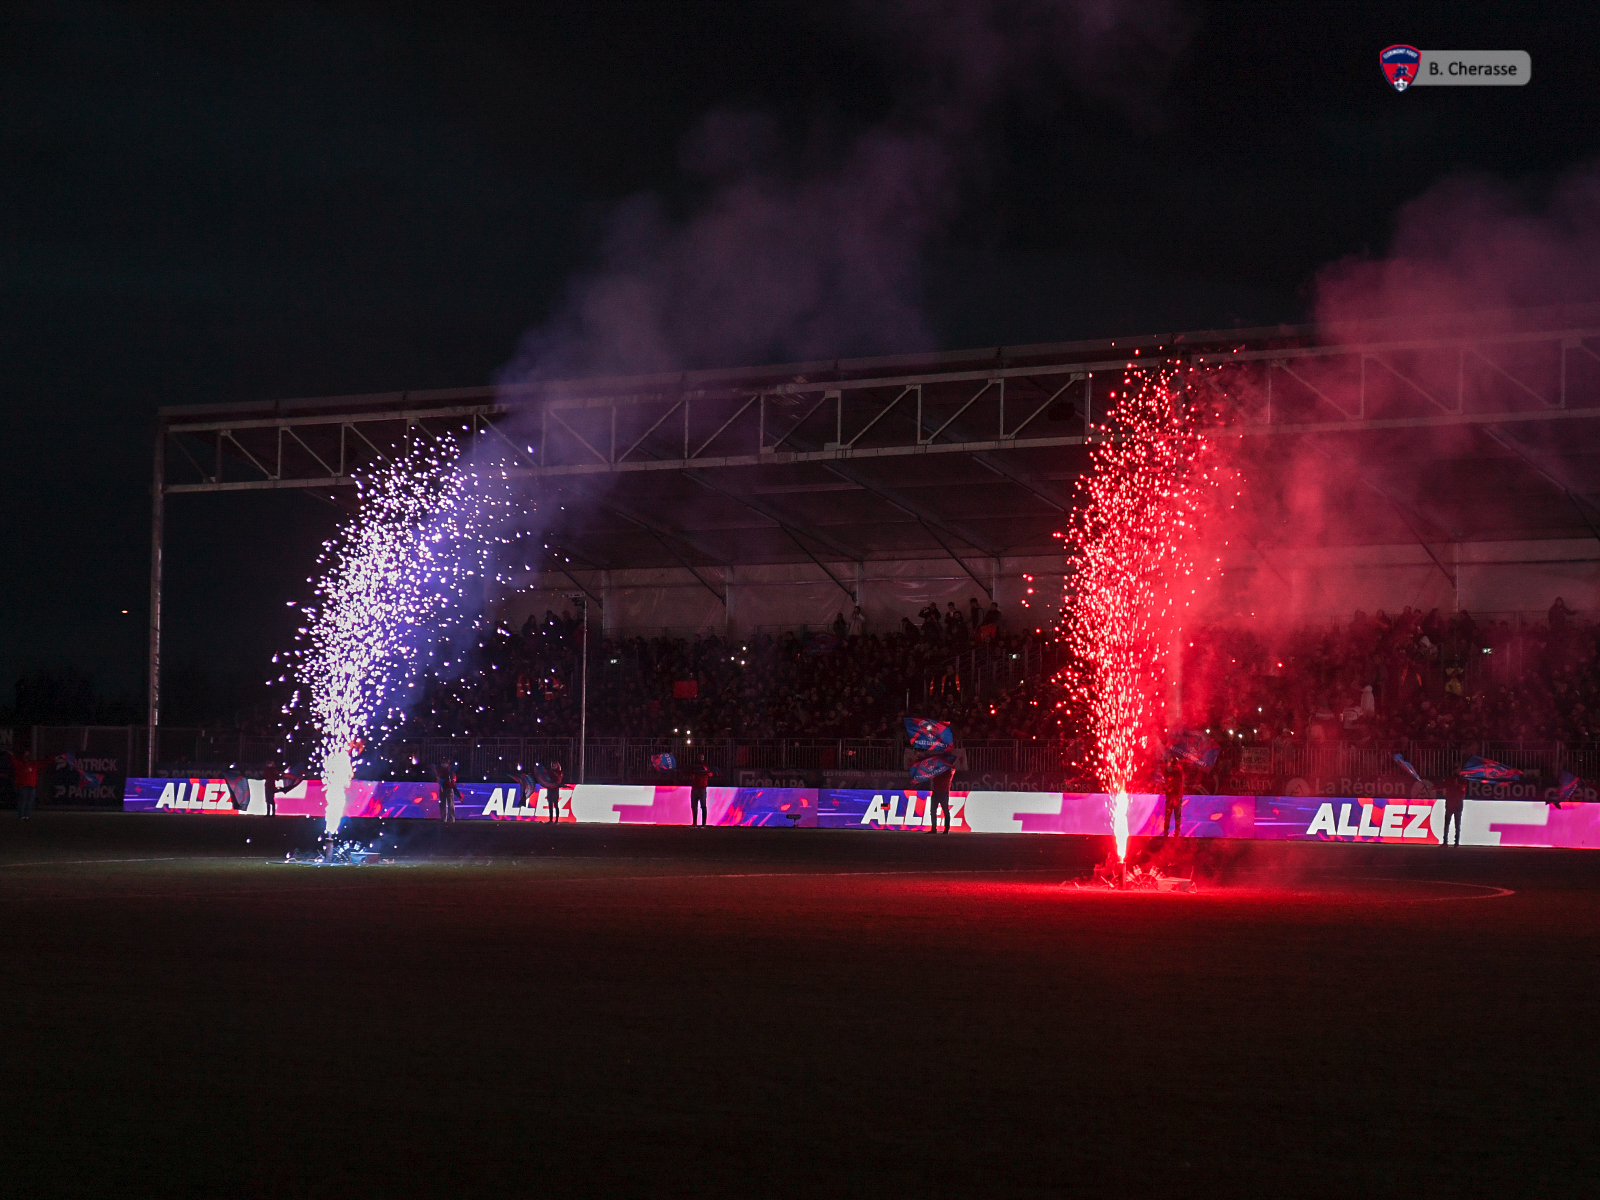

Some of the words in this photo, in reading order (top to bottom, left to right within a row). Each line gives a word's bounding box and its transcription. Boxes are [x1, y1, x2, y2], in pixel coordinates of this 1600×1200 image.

[155, 783, 233, 810] ALLEZ
[1315, 777, 1336, 794] La
[1340, 777, 1406, 797] Région
[1306, 803, 1432, 838] ALLEZ
